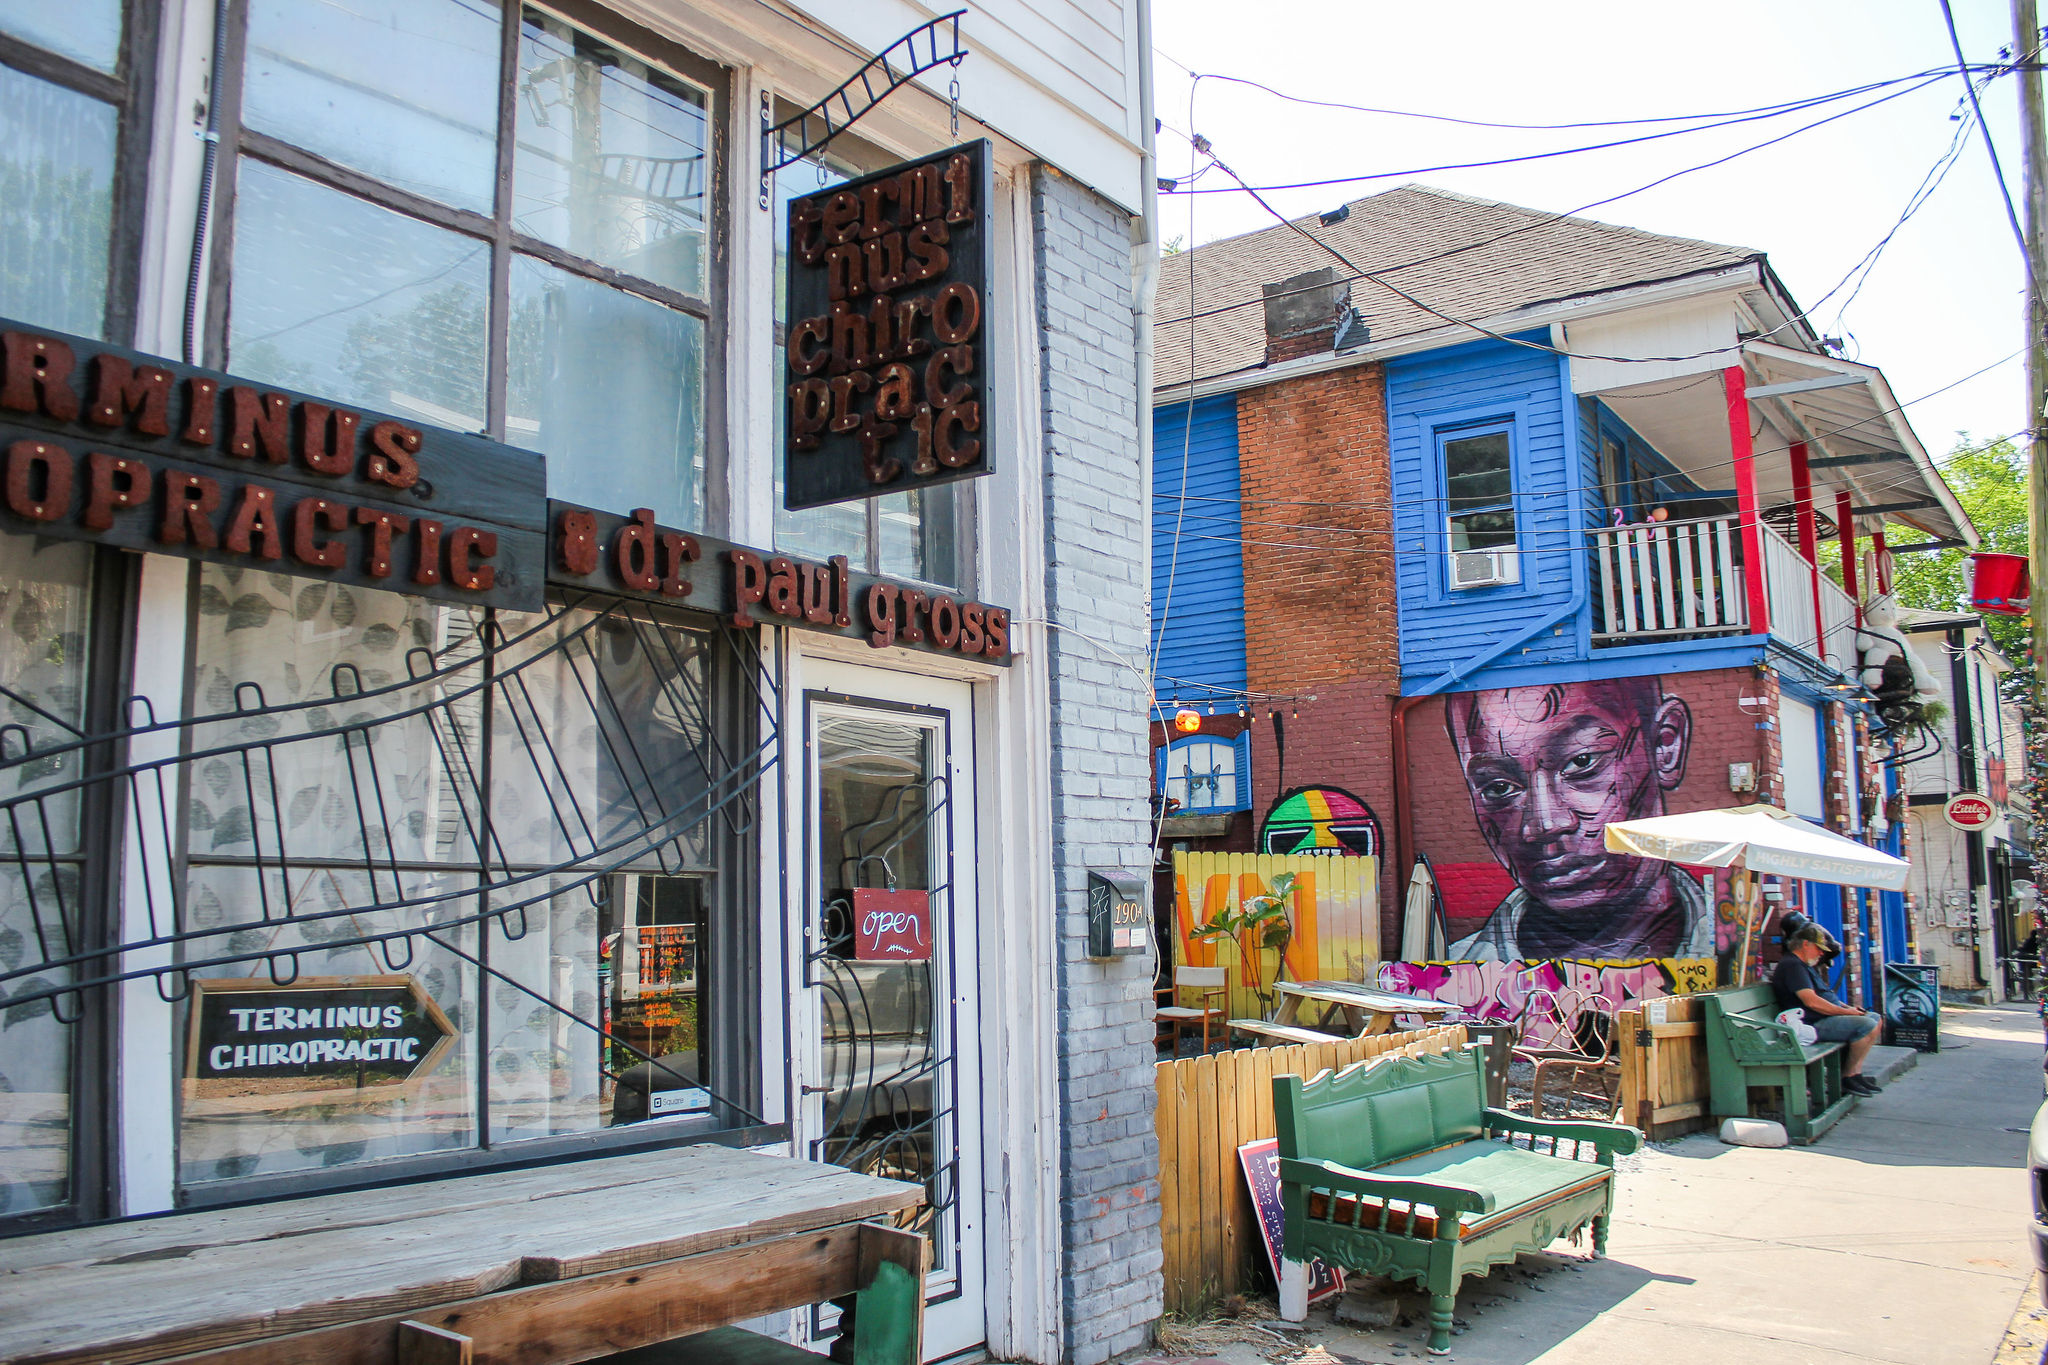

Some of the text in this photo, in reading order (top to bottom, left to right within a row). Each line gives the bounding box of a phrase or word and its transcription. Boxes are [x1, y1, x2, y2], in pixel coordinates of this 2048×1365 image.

[824, 218, 950, 301] nus
[789, 344, 974, 450] prac
[857, 401, 981, 484] tic
[612, 507, 1010, 659] dr paul gross
[1755, 851, 1897, 881] HIGHLY SATISFYING
[862, 910, 924, 951] open
[229, 1005, 404, 1033] TERMINUS
[209, 1037, 421, 1071] CHIROPRACTIC
